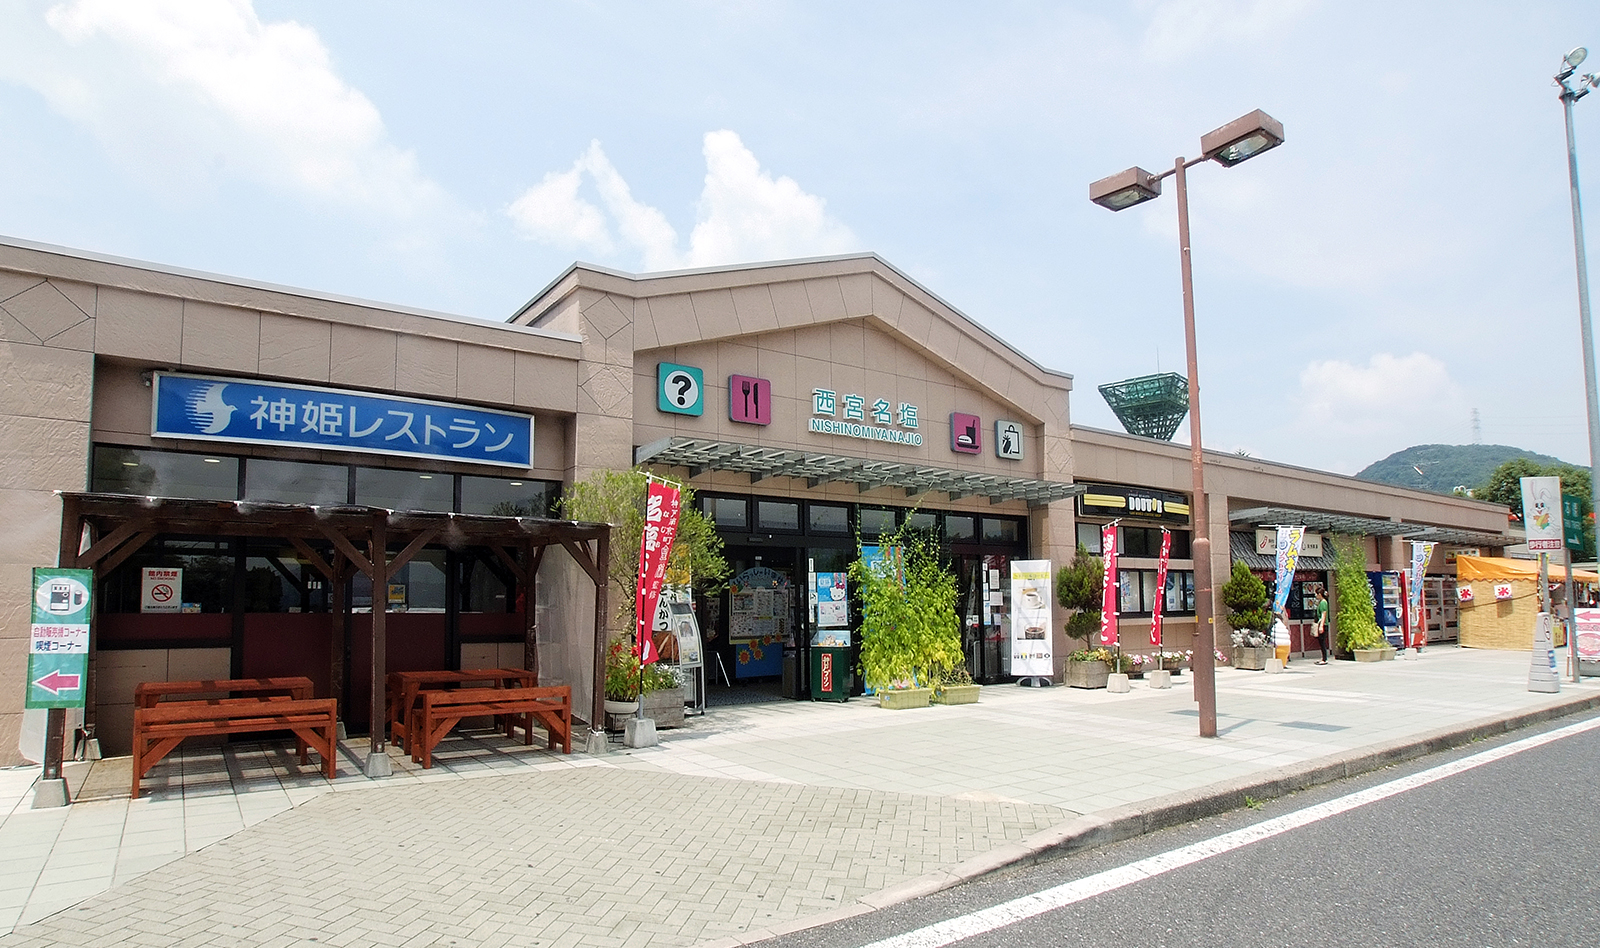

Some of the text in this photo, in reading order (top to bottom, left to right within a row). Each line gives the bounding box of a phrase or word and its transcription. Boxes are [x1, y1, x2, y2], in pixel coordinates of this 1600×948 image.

[812, 388, 919, 428] 西宮名塩
[250, 395, 514, 452] 神姫レストラン
[809, 418, 923, 446] NISHINOMIYANAJIO
[1128, 496, 1162, 514] DOUTOR
[1285, 529, 1302, 574] ラムネ
[33, 627, 87, 638] 自動販売機コーナー
[35, 640, 82, 651] 喫煙コーナー
